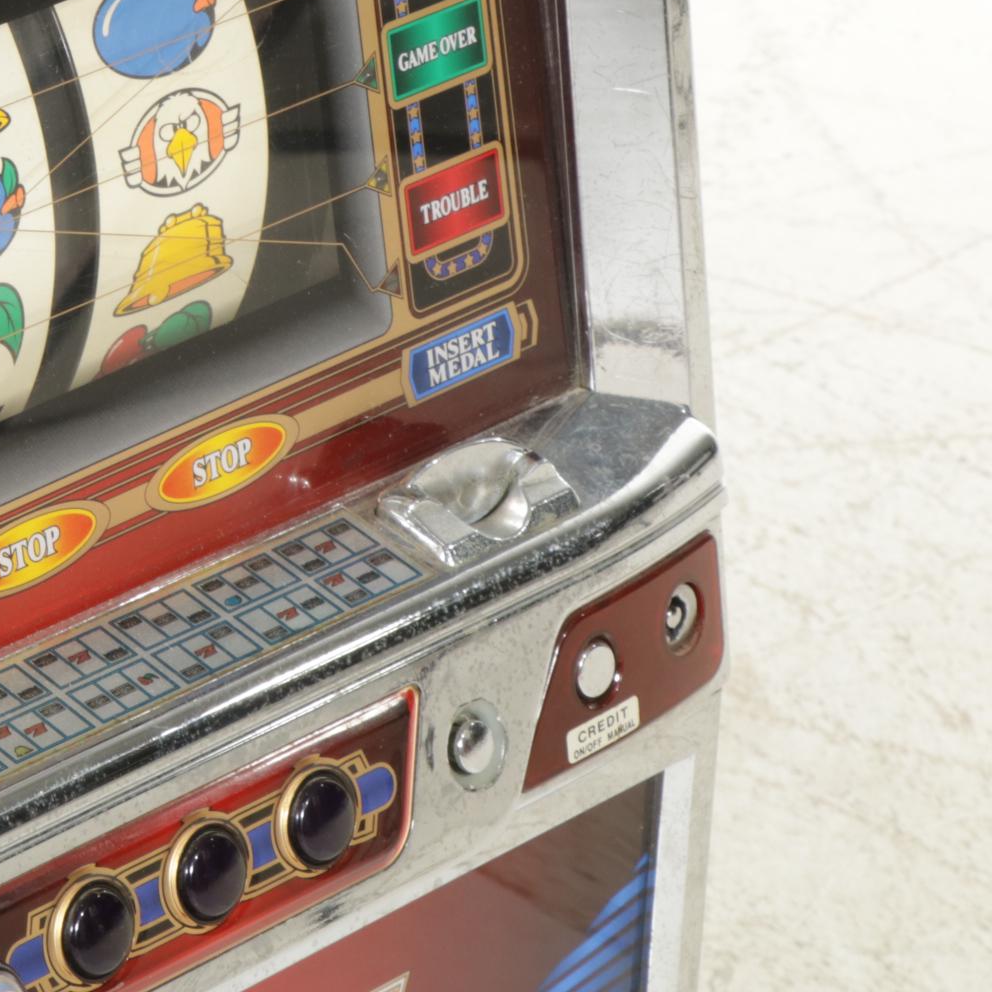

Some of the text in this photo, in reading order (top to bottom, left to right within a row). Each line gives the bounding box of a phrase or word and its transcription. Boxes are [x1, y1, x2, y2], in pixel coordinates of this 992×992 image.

[397, 25, 478, 73] GAME OVER
[419, 178, 489, 226] TROUBLE
[424, 320, 498, 369] INSERT
[427, 342, 501, 389] MEDAL
[191, 435, 255, 491] STOP
[577, 706, 628, 743] CREDIT
